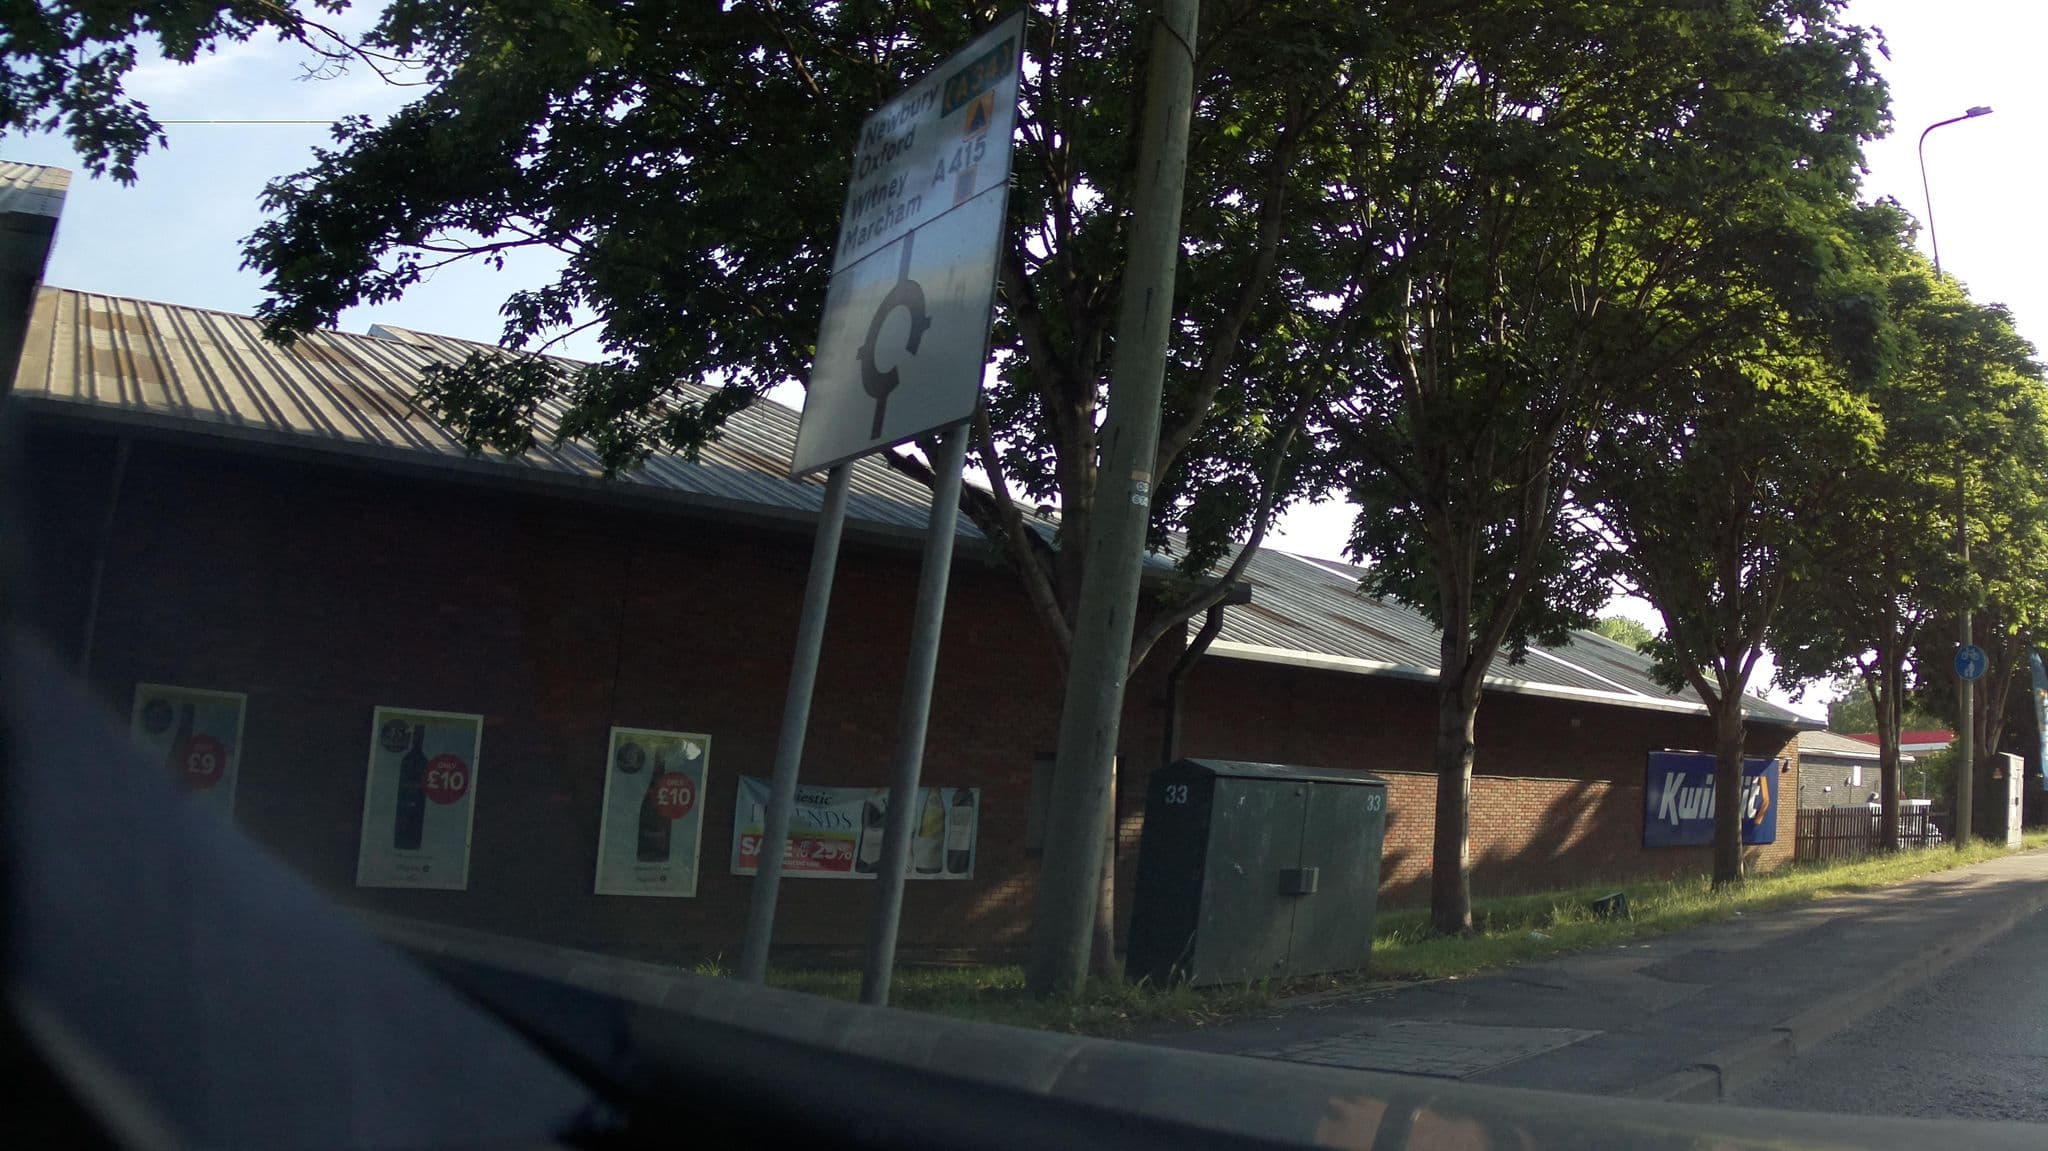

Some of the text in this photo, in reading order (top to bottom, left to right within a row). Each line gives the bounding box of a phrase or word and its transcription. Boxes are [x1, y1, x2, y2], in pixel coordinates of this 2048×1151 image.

[865, 84, 939, 144] Newbury
[858, 125, 917, 179] Oxford
[851, 172, 908, 221] Witney
[842, 195, 922, 256] Marcham
[186, 752, 216, 775] £9
[427, 769, 465, 790] £10
[657, 787, 691, 806] £10
[1166, 785, 1188, 804] 33
[1367, 795, 1382, 812] 33
[742, 836, 793, 855] SAE
